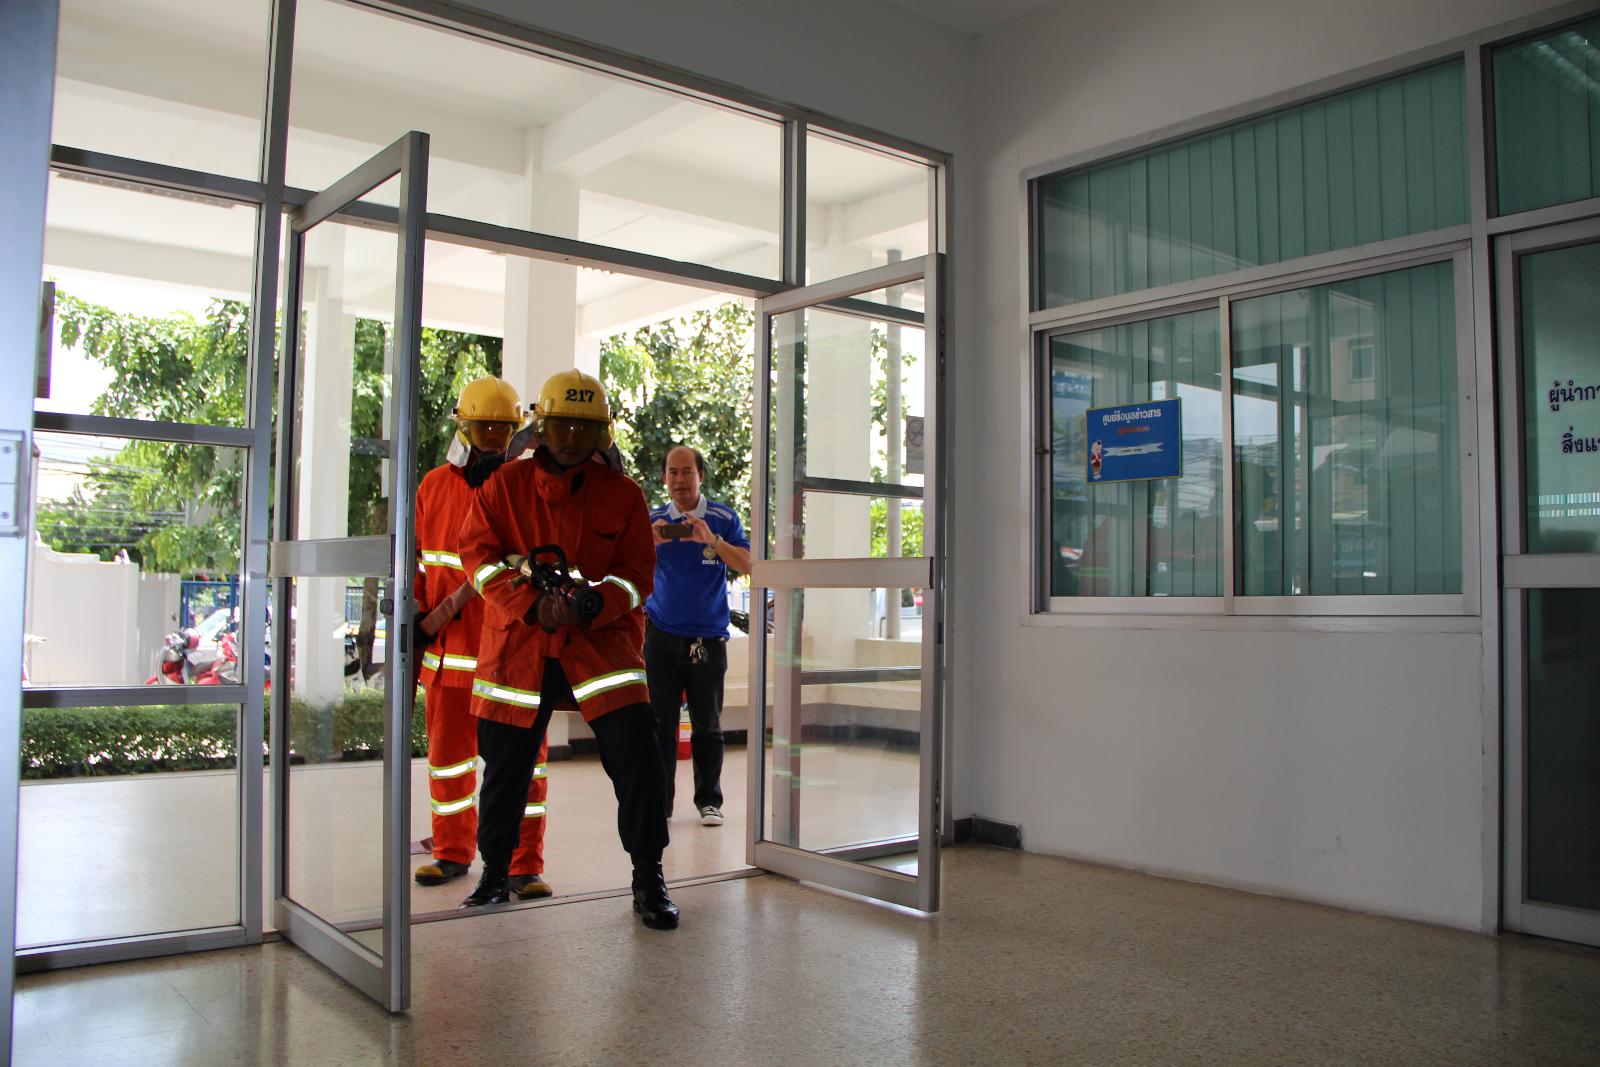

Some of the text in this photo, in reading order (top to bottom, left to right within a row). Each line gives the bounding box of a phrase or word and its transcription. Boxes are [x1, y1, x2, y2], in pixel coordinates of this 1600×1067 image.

[565, 389, 594, 403] 217
[1102, 408, 1162, 426] ศูนย์ข้อมูลข่าวสาร
[1562, 426, 1600, 453] สิ่งแ
